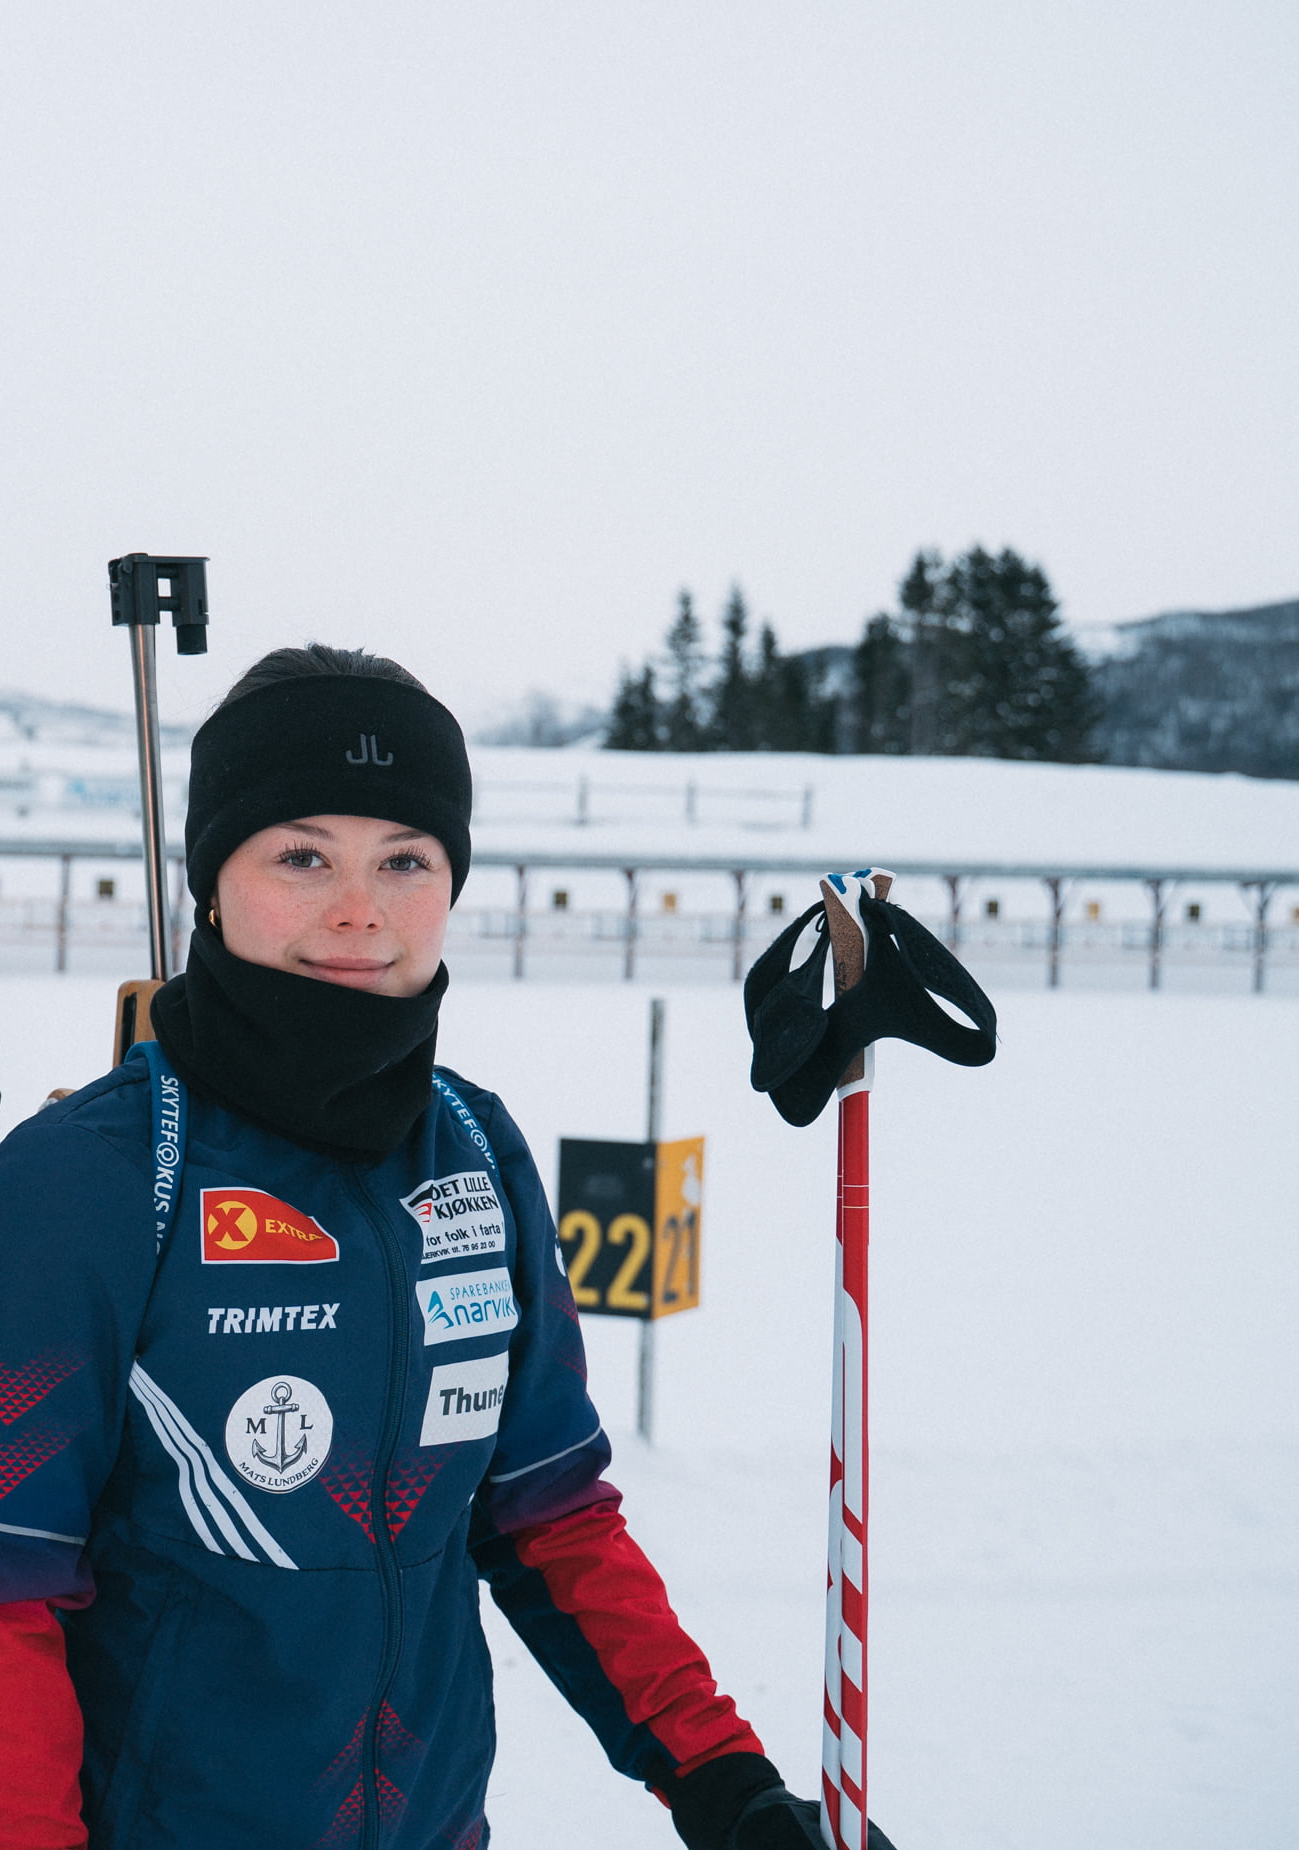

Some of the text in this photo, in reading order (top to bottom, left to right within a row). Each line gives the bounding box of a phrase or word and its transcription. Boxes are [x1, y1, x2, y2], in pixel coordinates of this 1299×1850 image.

[432, 1176, 491, 1201] DET LILLE
[433, 1194, 499, 1220] KJØKKEN
[265, 1218, 324, 1242] EXTRA
[445, 1228, 470, 1242] folk
[471, 1225, 478, 1237] i
[422, 1247, 451, 1260] JERKVIK
[488, 1240, 496, 1248] 00
[559, 1208, 652, 1310] 22
[207, 1303, 341, 1334] TRIMTEX
[245, 1414, 314, 1434] M L
[238, 1457, 320, 1488] MATS LUNDBERG
